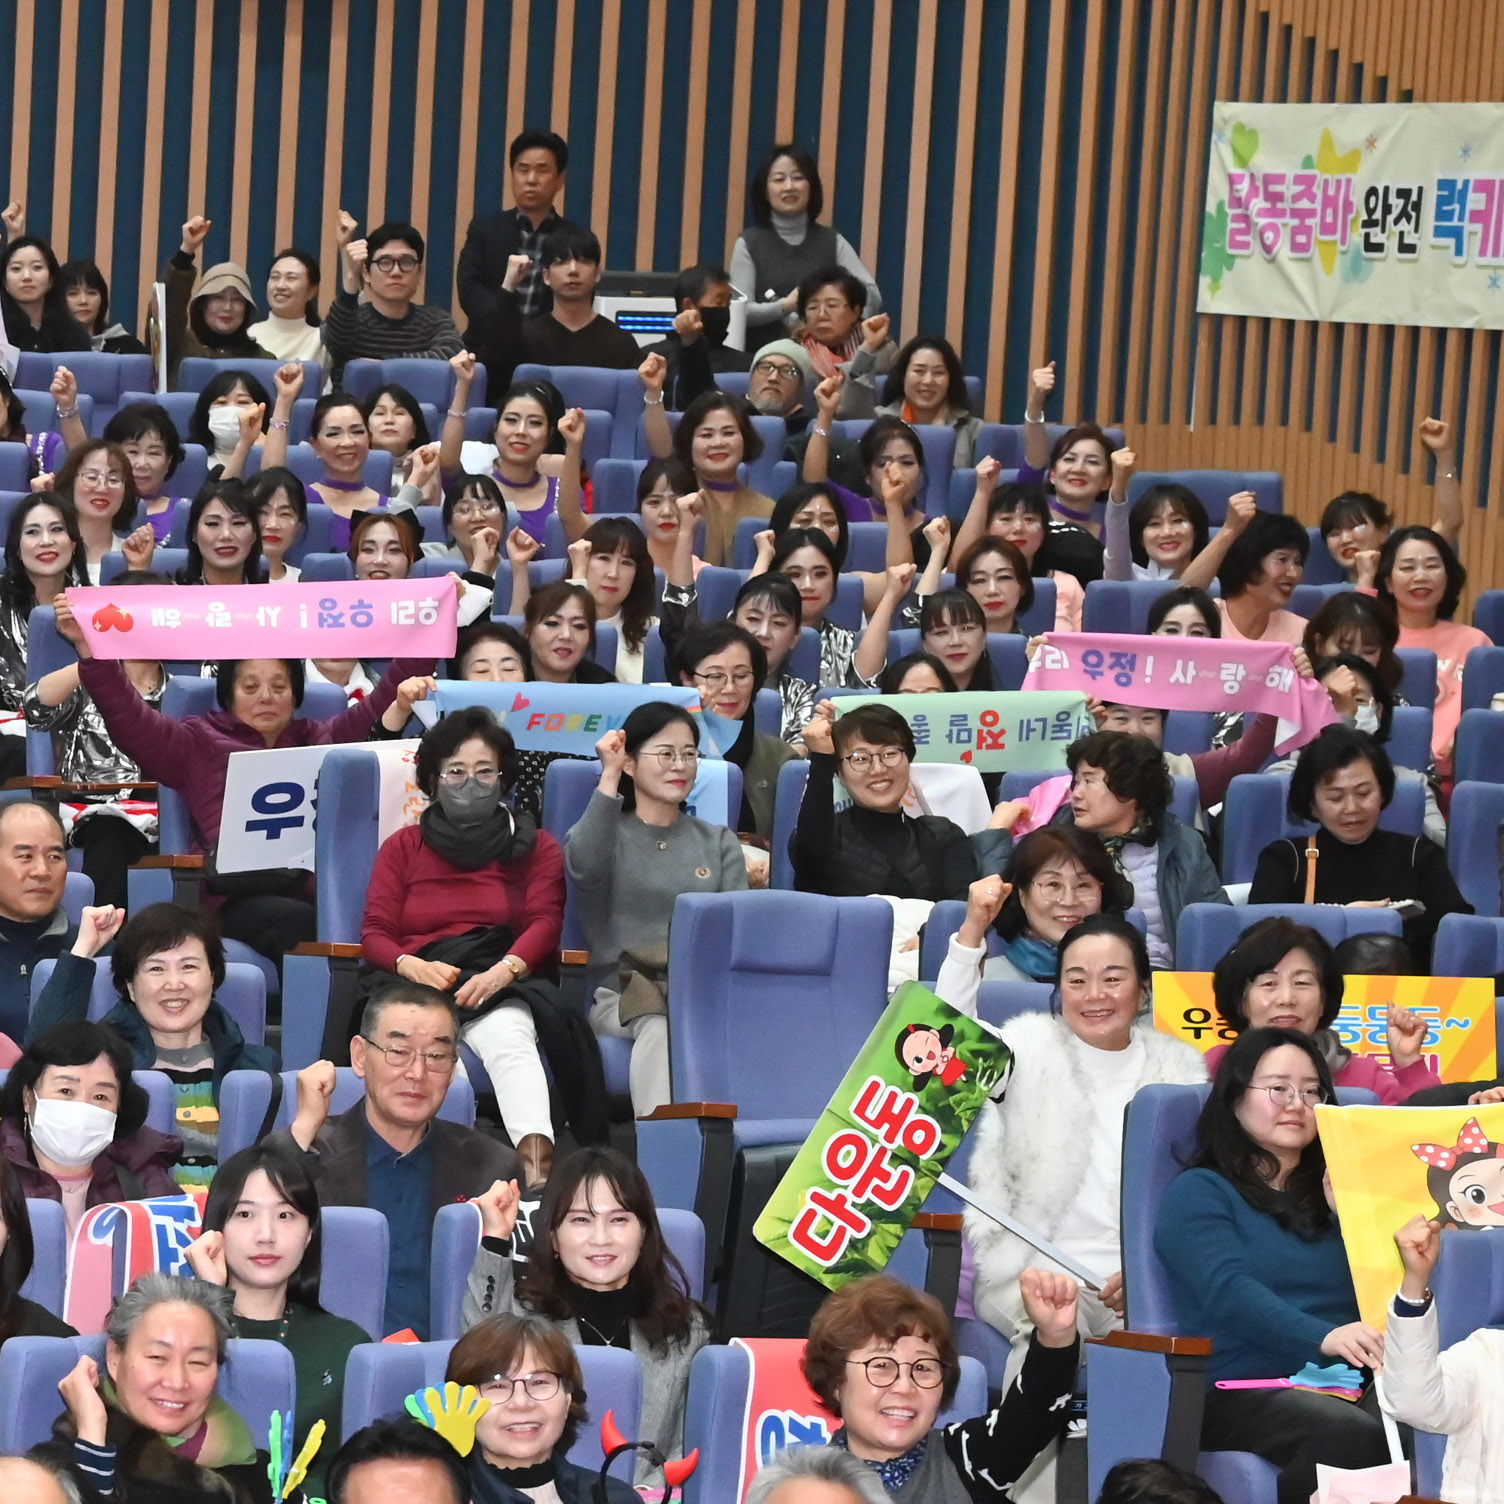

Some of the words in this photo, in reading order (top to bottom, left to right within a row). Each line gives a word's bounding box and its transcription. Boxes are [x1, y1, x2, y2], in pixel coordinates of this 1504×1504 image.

[1360, 185, 1424, 254] 완전
[945, 709, 1006, 750] 정말
[791, 1080, 937, 1262] 다운동
